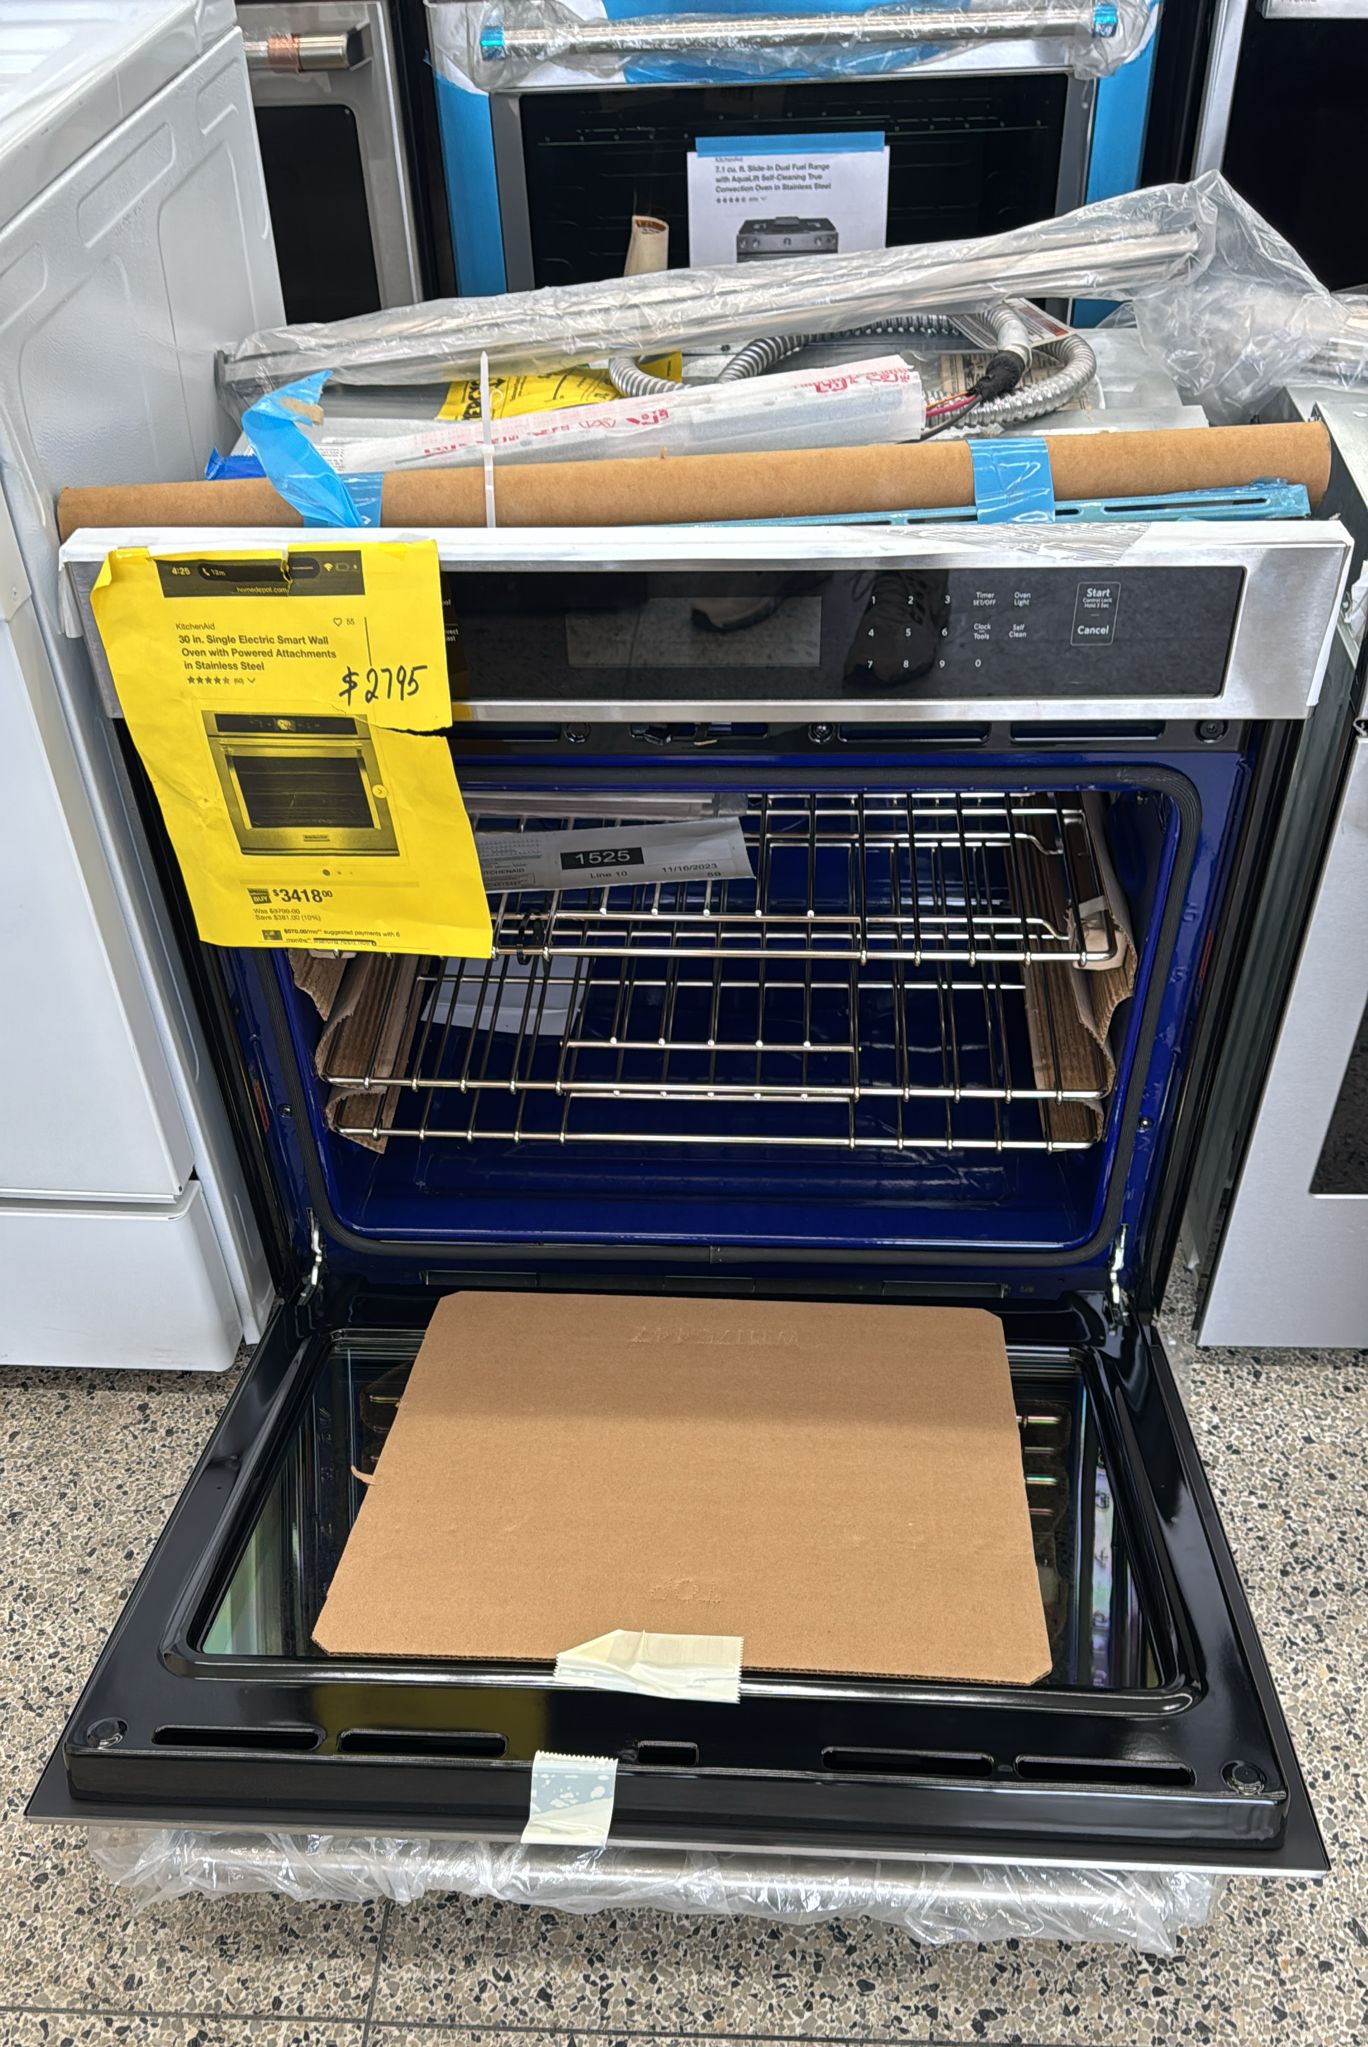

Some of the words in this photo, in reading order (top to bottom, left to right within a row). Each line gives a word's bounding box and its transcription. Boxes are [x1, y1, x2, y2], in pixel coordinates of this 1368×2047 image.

[775, 163, 790, 172] Dual
[792, 163, 807, 171] Fuel
[808, 162, 830, 172] Range
[715, 175, 730, 183] with
[761, 173, 807, 182] Self-Cleaning
[715, 185, 753, 193] Convection
[782, 182, 813, 190] Stainless
[976, 591, 995, 599] Timer
[1014, 591, 1031, 599] Oven
[1086, 588, 1111, 598] Start
[871, 595, 876, 605] 1
[907, 595, 914, 605] 2
[944, 594, 951, 604] 3
[1014, 599, 1030, 608] Light
[176, 622, 216, 631] KitchenAid
[1077, 625, 1109, 635] Cancel
[868, 628, 874, 637] 4
[905, 628, 911, 637] 5
[942, 627, 948, 636] 6
[974, 632, 990, 640] Tools
[178, 635, 190, 644] 30
[192, 635, 204, 644] in.
[206, 635, 237, 646] Single
[238, 635, 275, 645] Electric
[277, 635, 306, 645] Smart
[308, 636, 329, 645] Wall
[181, 648, 206, 657] Oven
[208, 648, 230, 657] with
[232, 649, 273, 658] Powered
[276, 649, 337, 659] Attachments
[184, 661, 193, 670] in
[195, 661, 238, 671] Stainless
[240, 661, 265, 671] Steel
[867, 660, 873, 668] 7
[903, 659, 909, 668] 8
[940, 660, 945, 668] 9
[575, 850, 631, 865] 1525
